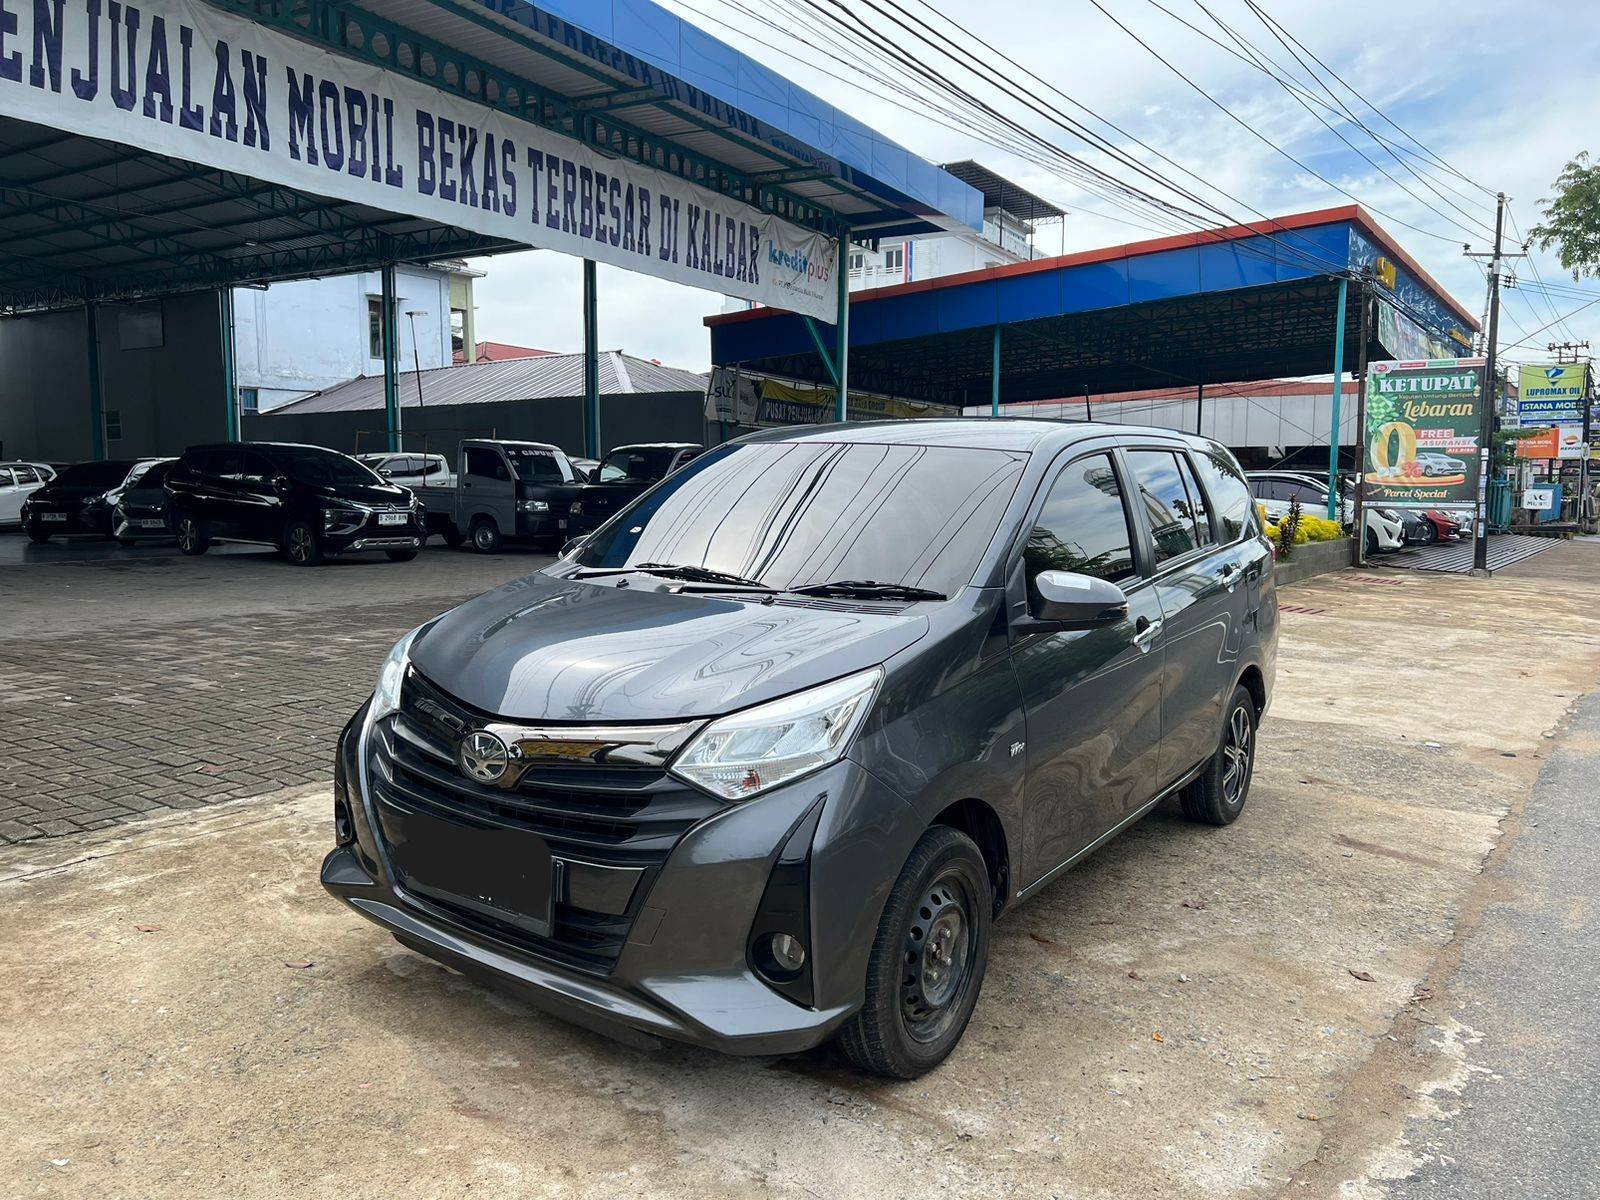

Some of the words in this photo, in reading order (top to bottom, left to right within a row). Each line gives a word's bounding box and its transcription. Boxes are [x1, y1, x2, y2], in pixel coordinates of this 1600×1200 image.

[286, 65, 403, 188] MOBIL
[416, 109, 517, 218] BEKAS
[527, 147, 652, 256] TERBESAR
[658, 193, 680, 265] DI
[685, 203, 761, 285] KALBAR
[768, 239, 829, 282] kreditplus
[1379, 376, 1475, 393] KETUPAT
[1526, 388, 1567, 396] LUPROMAX
[1569, 387, 1580, 395] OIL
[1403, 400, 1474, 422] Lebaran
[1521, 402, 1553, 410] ISTANA
[1420, 429, 1451, 438] FREE
[1422, 439, 1471, 447] ASURANSI
[1383, 489, 1412, 498] Parcel
[1413, 488, 1448, 500] Special
